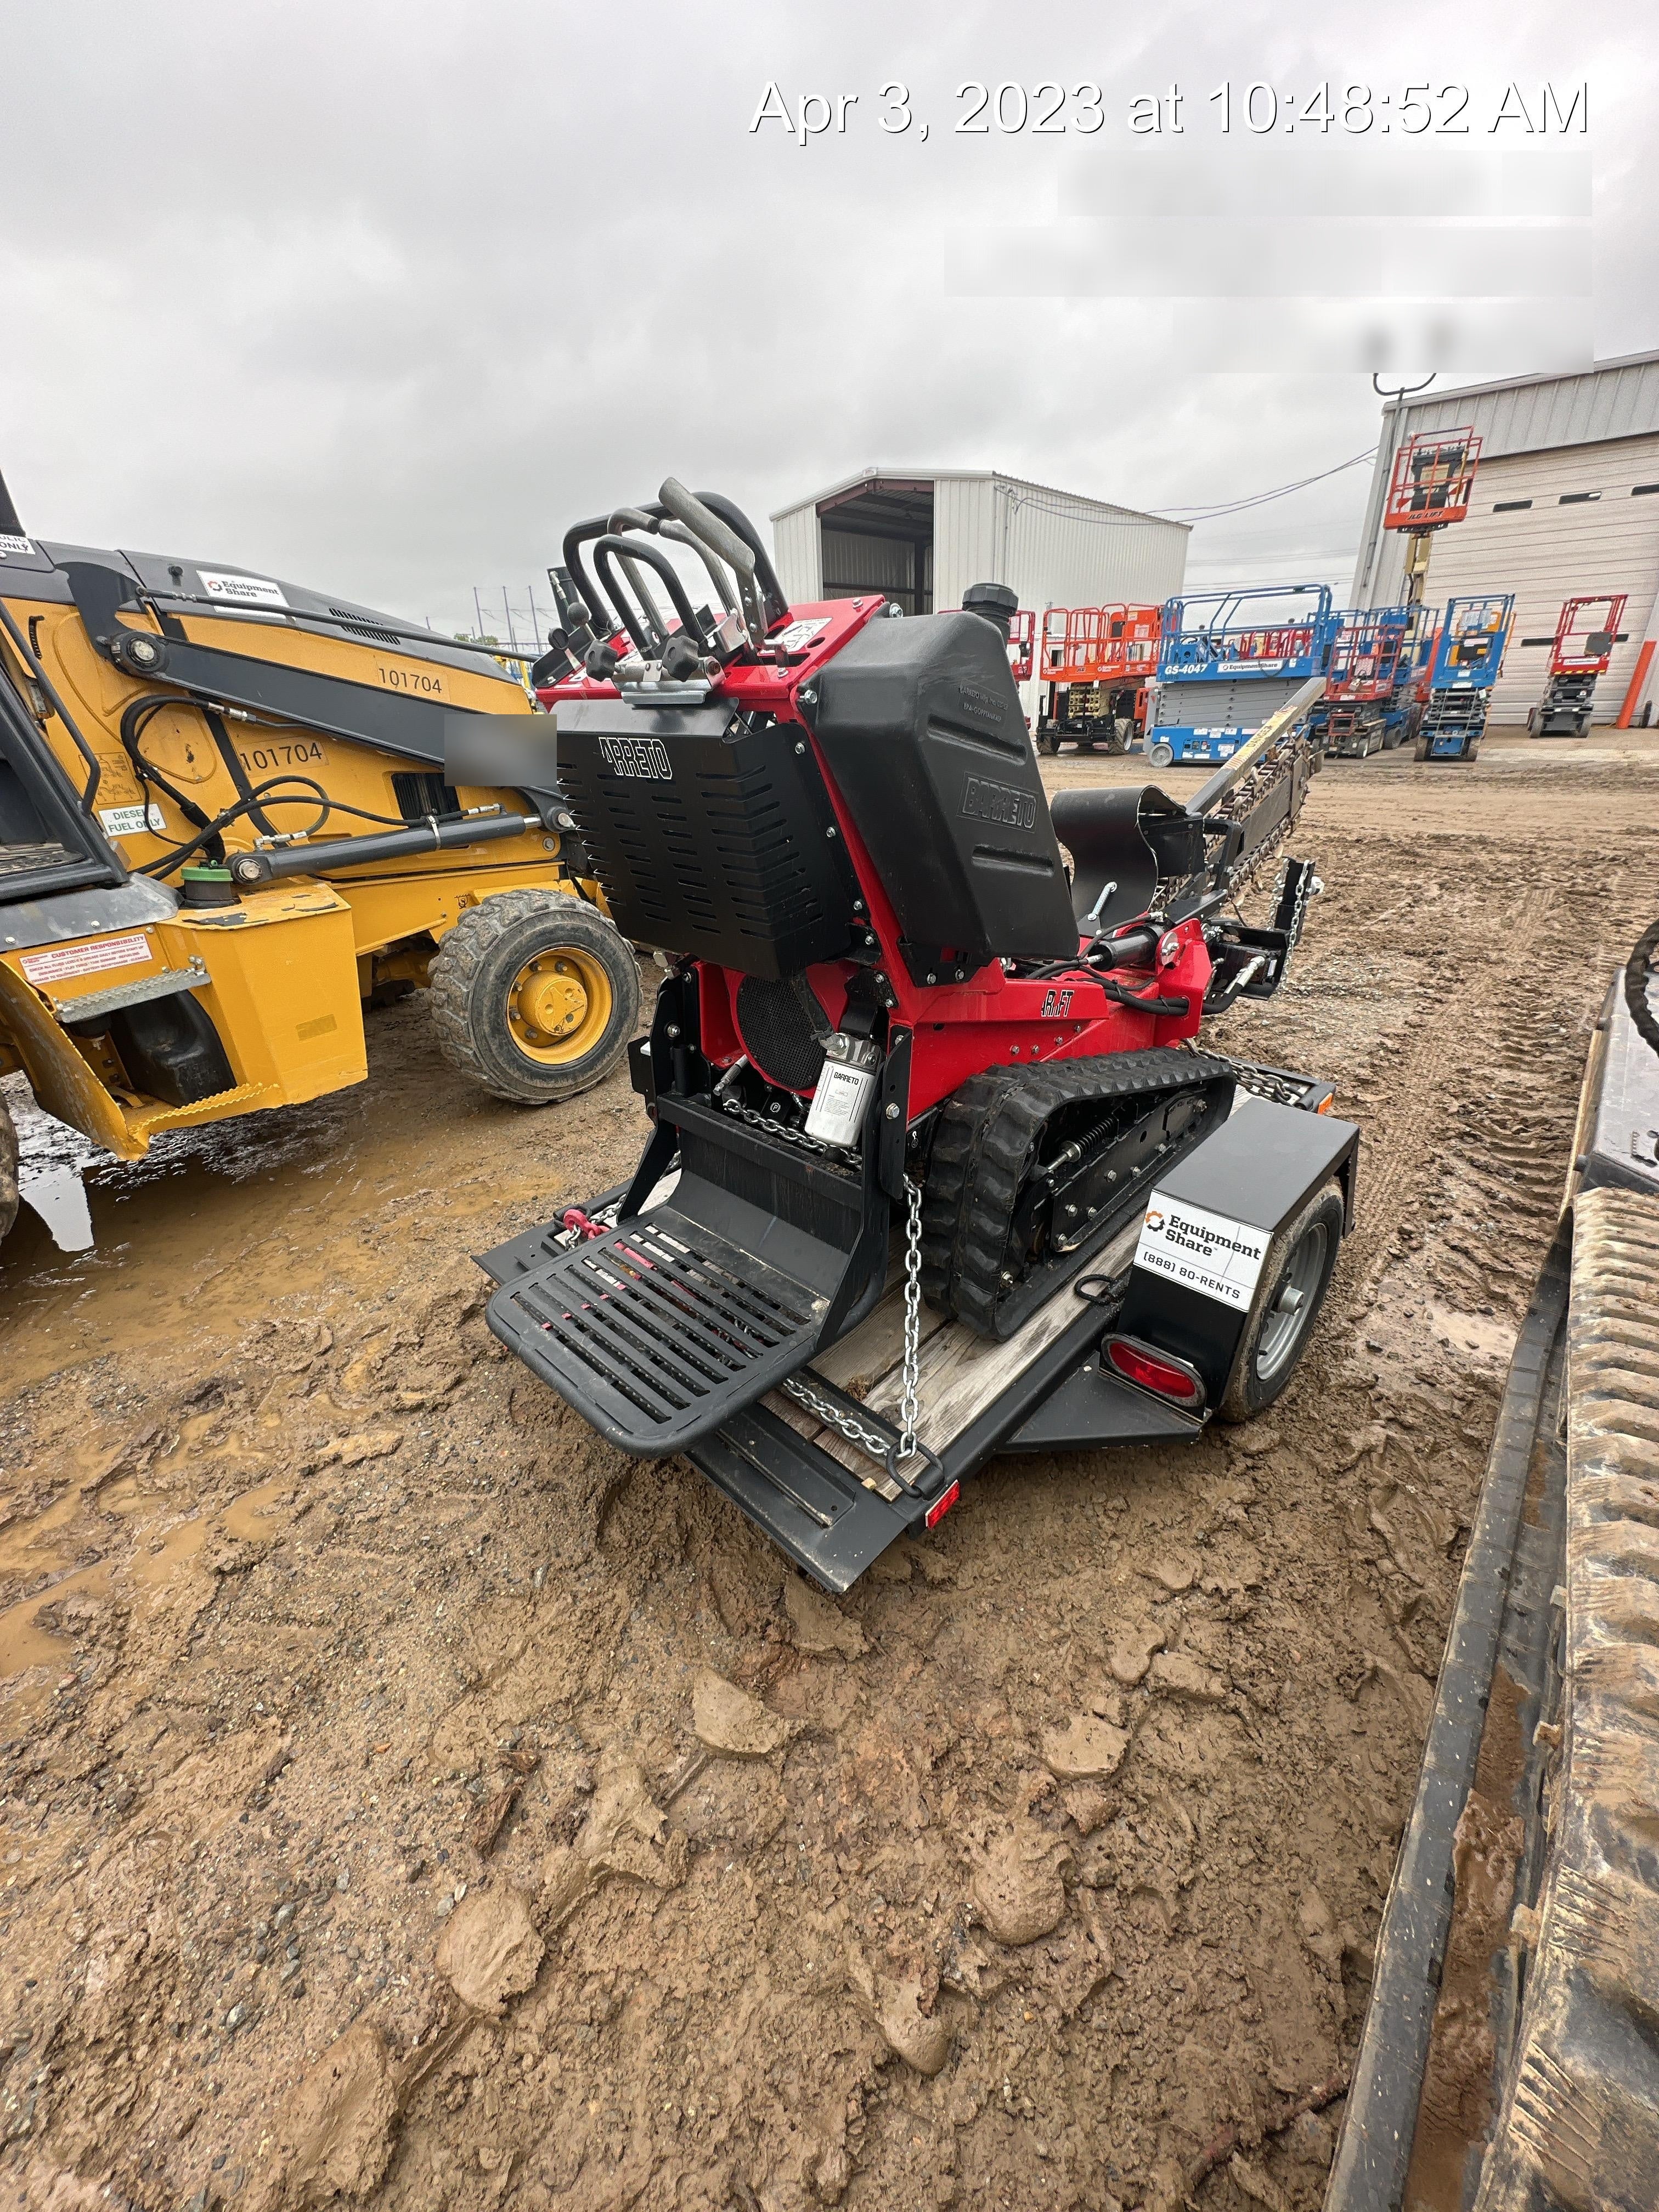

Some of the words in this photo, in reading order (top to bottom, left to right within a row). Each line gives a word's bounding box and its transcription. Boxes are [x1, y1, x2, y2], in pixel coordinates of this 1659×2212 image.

[221, 580, 280, 595] Equipment
[225, 588, 258, 597] Share
[379, 668, 442, 693] 101704
[1164, 663, 1208, 675] GS-4047
[240, 742, 322, 771] 101704
[108, 822, 135, 833] FUEL
[50, 946, 89, 958] CUSTOMER
[89, 935, 144, 950] RESPONSIBILITY
[834, 1071, 859, 1085] BARRETO
[1165, 1228, 1213, 1256] Share
[1169, 1214, 1261, 1260] Equipment
[1143, 1251, 1176, 1272] (888)
[1179, 1267, 1241, 1299] 80-RENTS
